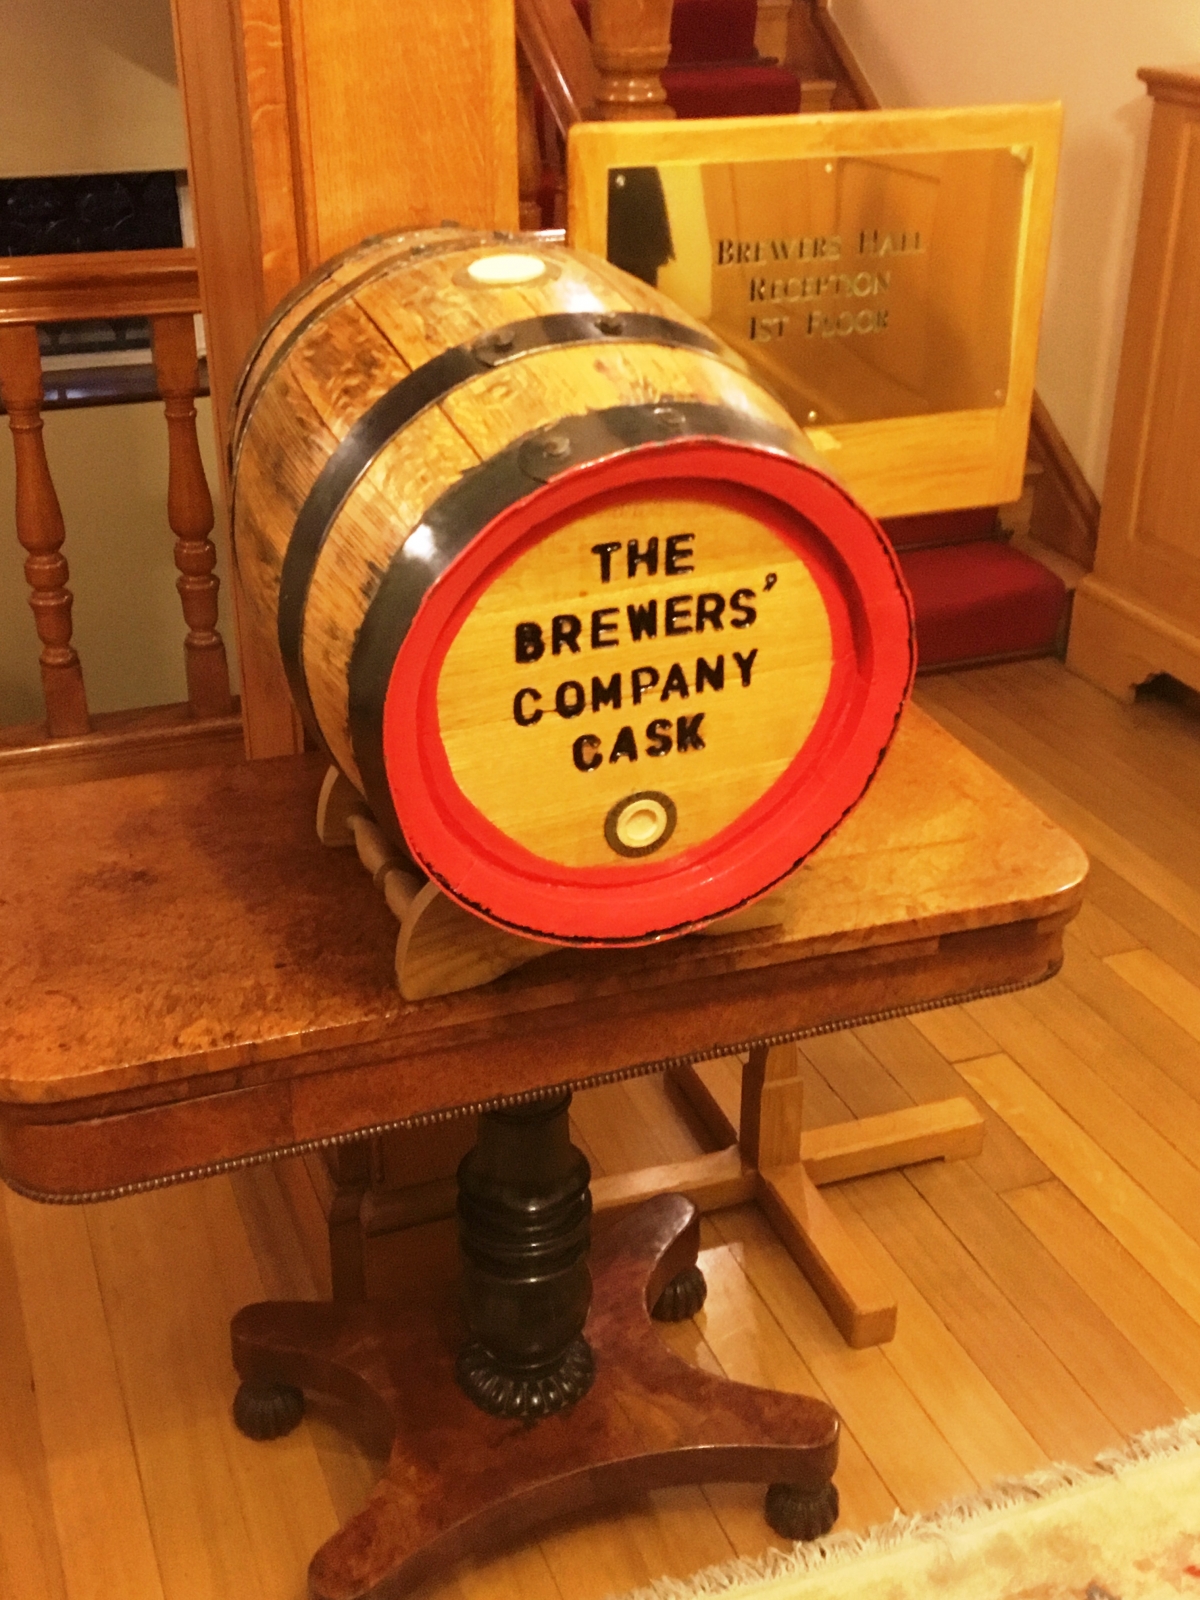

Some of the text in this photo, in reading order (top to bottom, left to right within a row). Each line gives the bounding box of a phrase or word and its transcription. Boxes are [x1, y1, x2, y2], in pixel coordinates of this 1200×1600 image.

[718, 229, 925, 266] BREWERS HALL
[750, 270, 891, 304] RECEPTION
[806, 309, 889, 338] FLOOR
[591, 533, 695, 583] THE
[515, 573, 777, 664] BREWERS'
[513, 648, 758, 726] COMPANY
[572, 712, 706, 772] CASK
